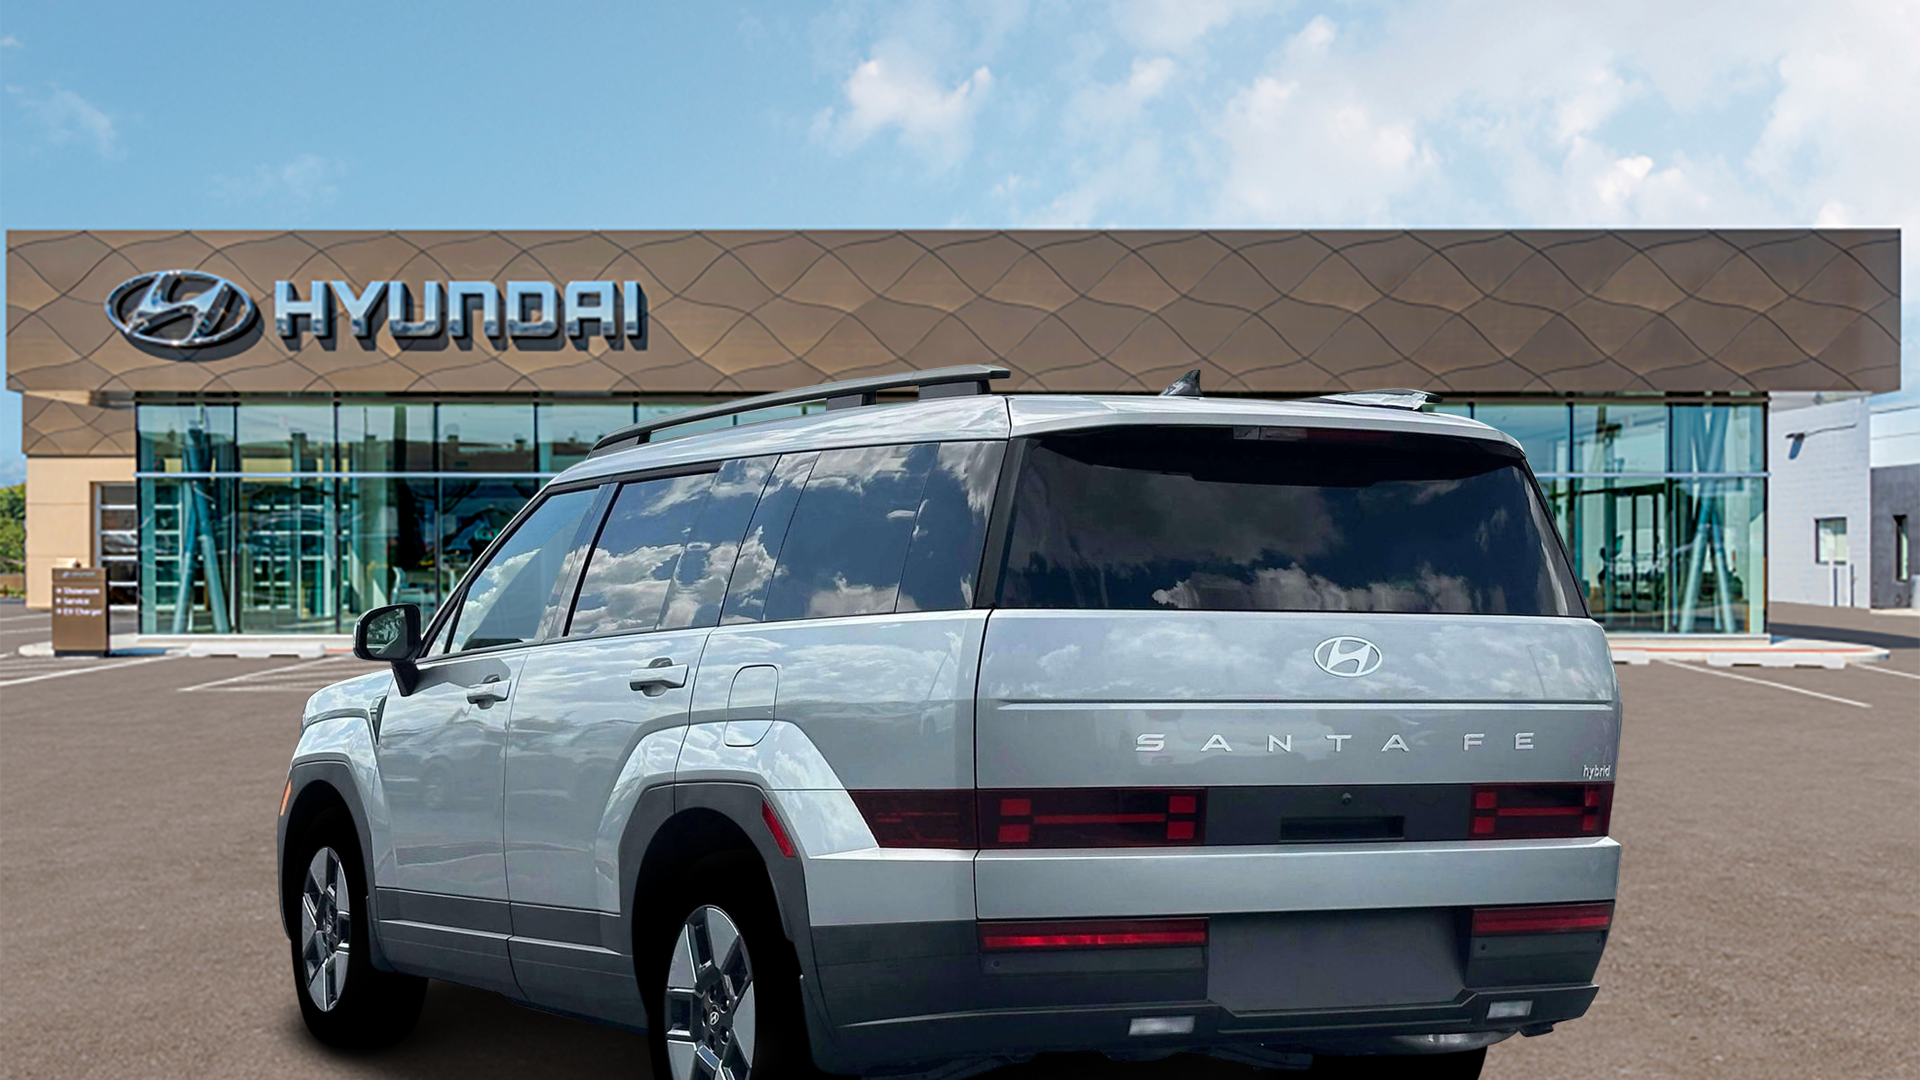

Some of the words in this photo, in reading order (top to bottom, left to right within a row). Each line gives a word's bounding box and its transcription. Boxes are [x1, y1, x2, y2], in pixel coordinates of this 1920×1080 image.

[274, 280, 640, 338] HYUNDAI
[1135, 733, 1410, 753] SANTA
[1463, 732, 1535, 751] FE
[1582, 764, 1611, 780] hybrid
